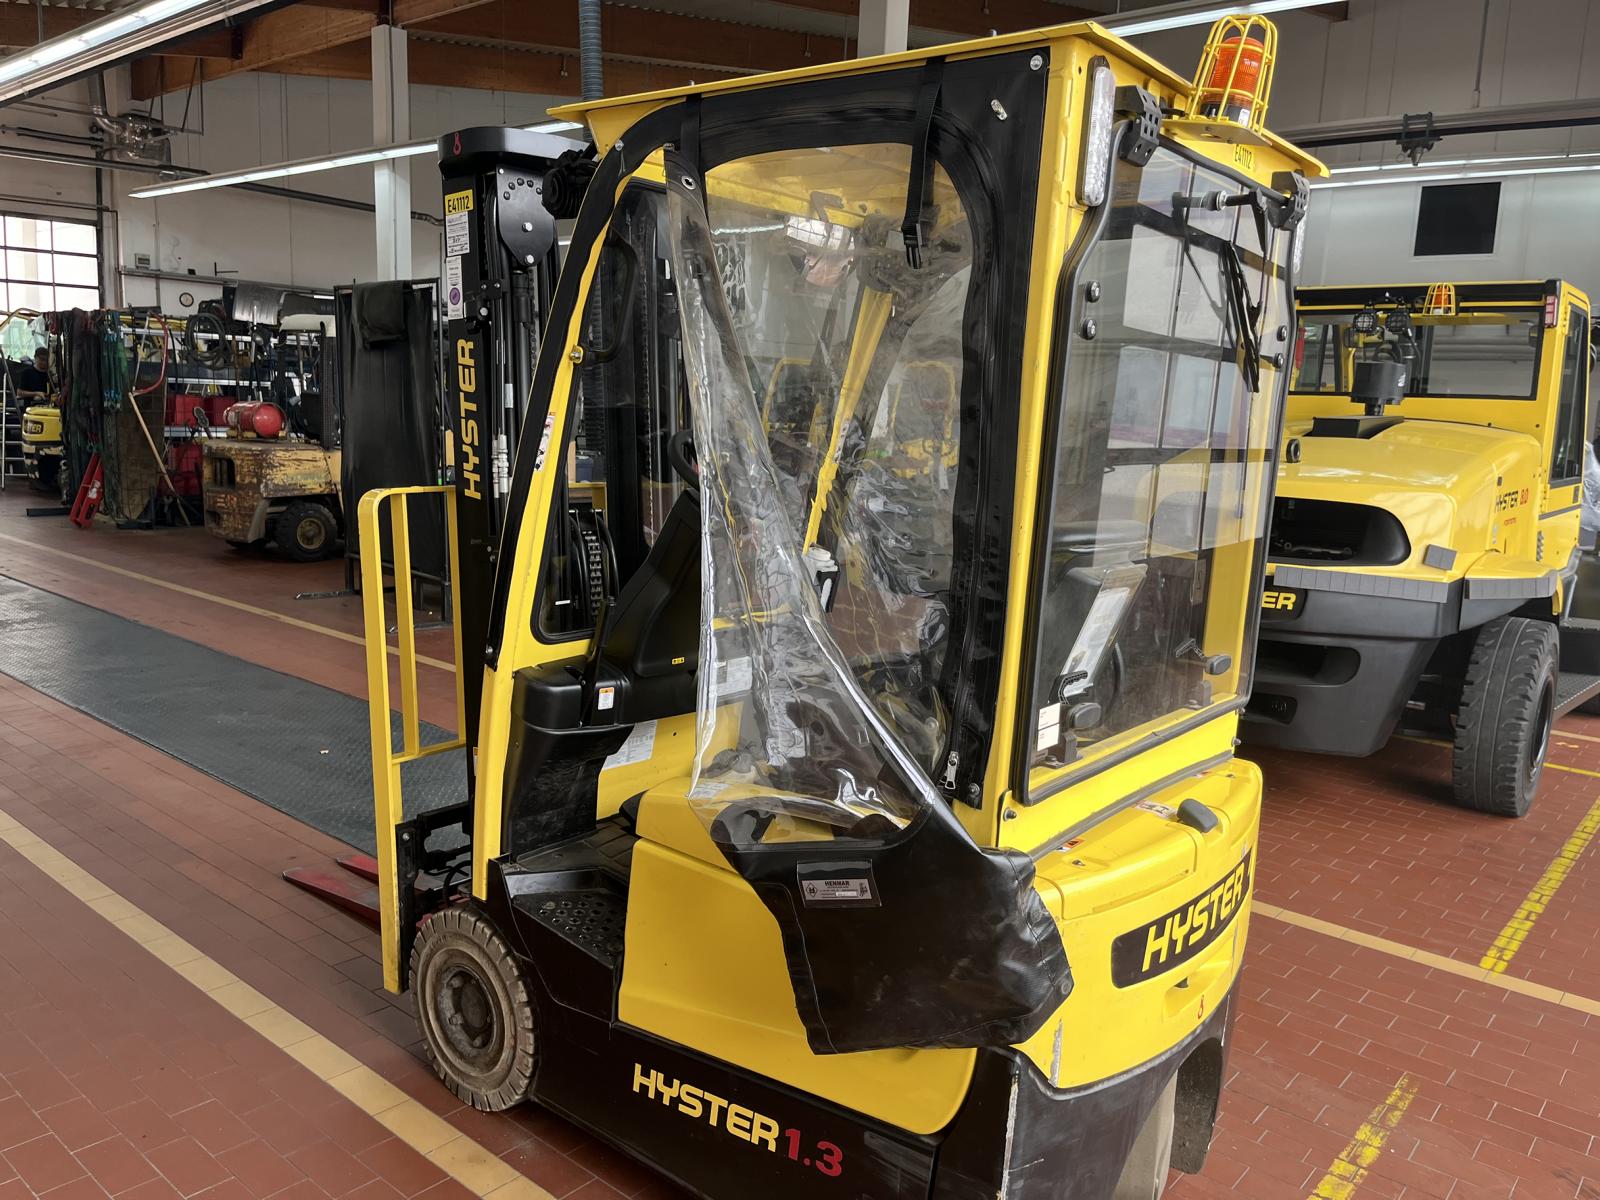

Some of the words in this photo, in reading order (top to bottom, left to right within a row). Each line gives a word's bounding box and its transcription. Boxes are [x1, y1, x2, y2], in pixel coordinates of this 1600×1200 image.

[1234, 143, 1252, 169] E41112
[447, 195, 470, 213] E41112
[457, 338, 481, 500] HYSTER
[1495, 490, 1518, 512] HYSTER
[1261, 591, 1297, 610] ER
[1142, 862, 1245, 973] HYSTER
[632, 1062, 780, 1153] HYSTER
[785, 1128, 843, 1177] 1.3
